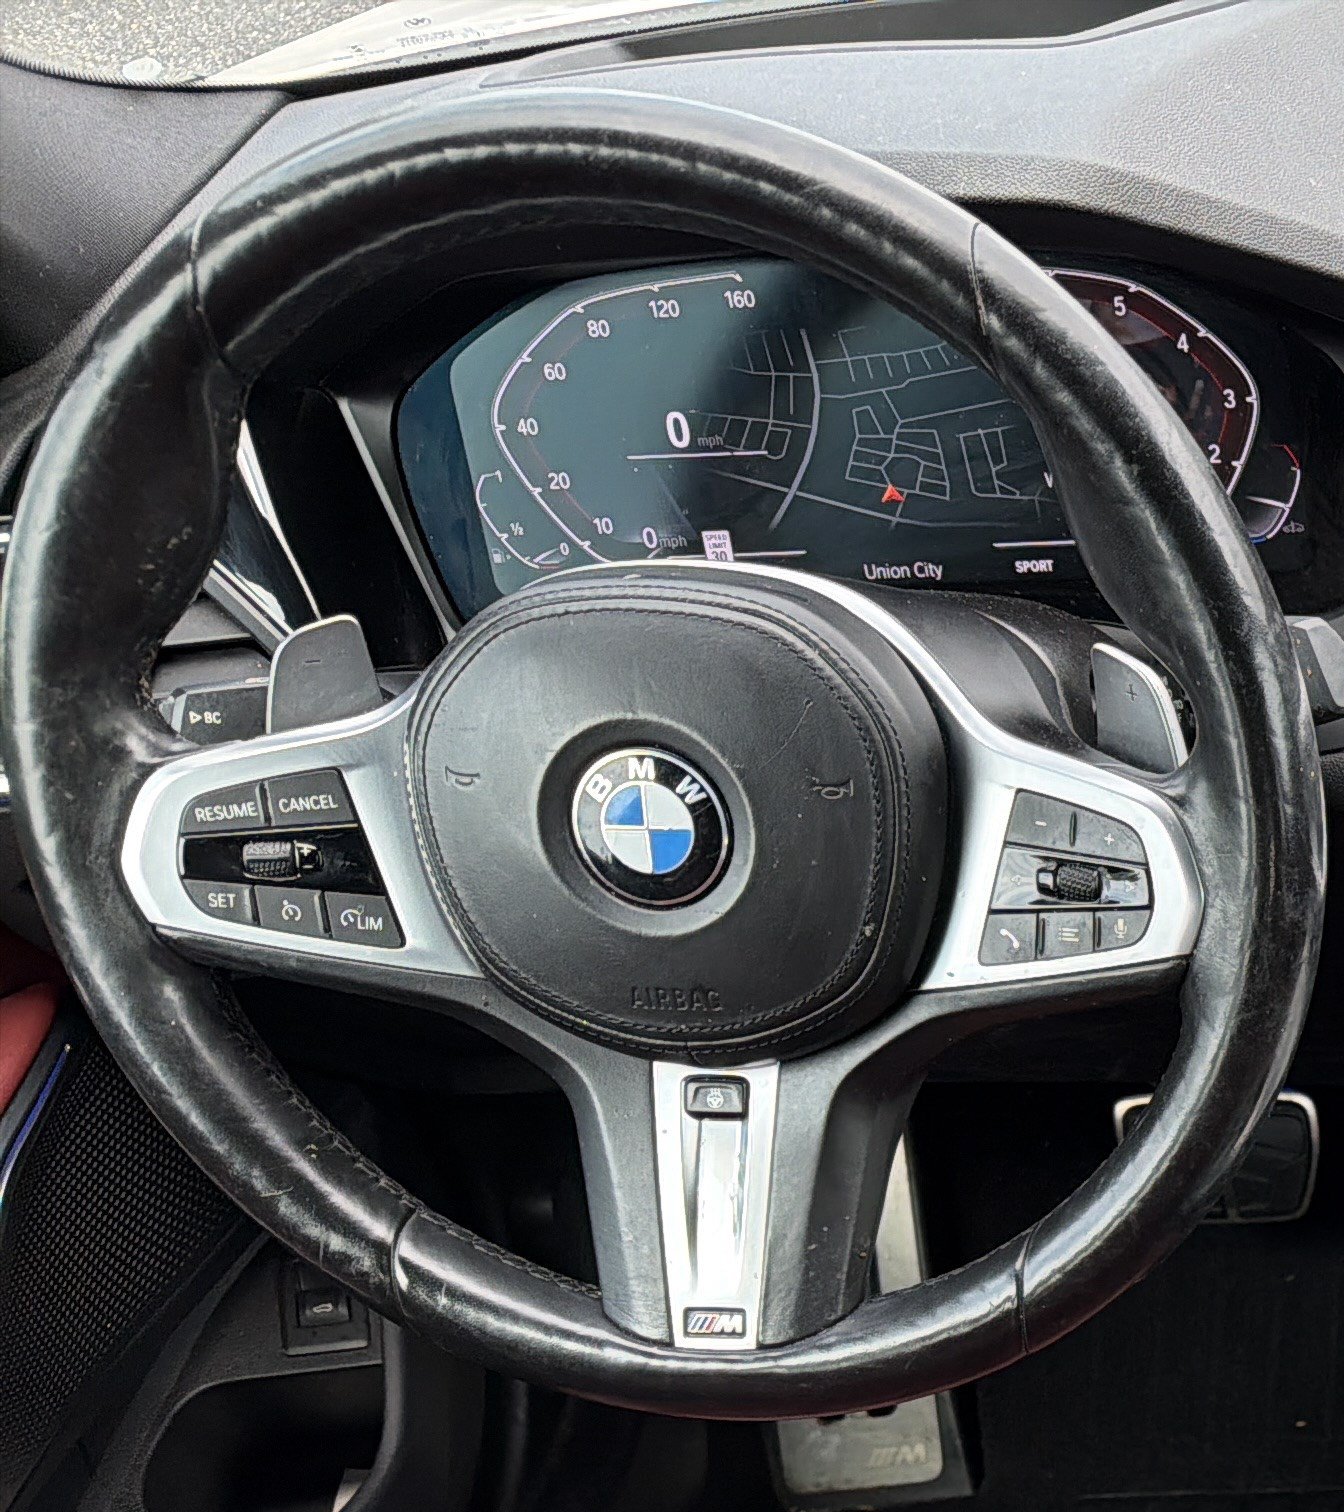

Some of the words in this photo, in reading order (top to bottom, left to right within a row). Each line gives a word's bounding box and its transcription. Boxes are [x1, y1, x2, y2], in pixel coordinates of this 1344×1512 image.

[649, 299, 680, 319] 120
[724, 289, 755, 309] 160
[1113, 296, 1126, 316] 5
[587, 319, 610, 338] 80
[1176, 334, 1189, 353] 4
[543, 363, 566, 382] 60
[1222, 389, 1236, 409] 3
[517, 417, 538, 437] 40
[665, 411, 691, 449] 0
[697, 434, 724, 449] mph
[1208, 444, 1222, 464] 2
[547, 471, 571, 490] 20
[592, 517, 613, 536] 10
[642, 527, 658, 549] 0
[659, 533, 687, 550] mph
[559, 542, 570, 556] 0
[863, 562, 912, 581] Union
[914, 561, 943, 582] City
[1015, 558, 1054, 574] SPORT
[203, 710, 222, 725] BC
[585, 757, 707, 805] BMW
[194, 801, 258, 823] RESUME
[278, 794, 339, 815] CANCEL
[207, 892, 236, 909] SET
[357, 915, 383, 932] LIM
[631, 984, 723, 1011] AIRBAG
